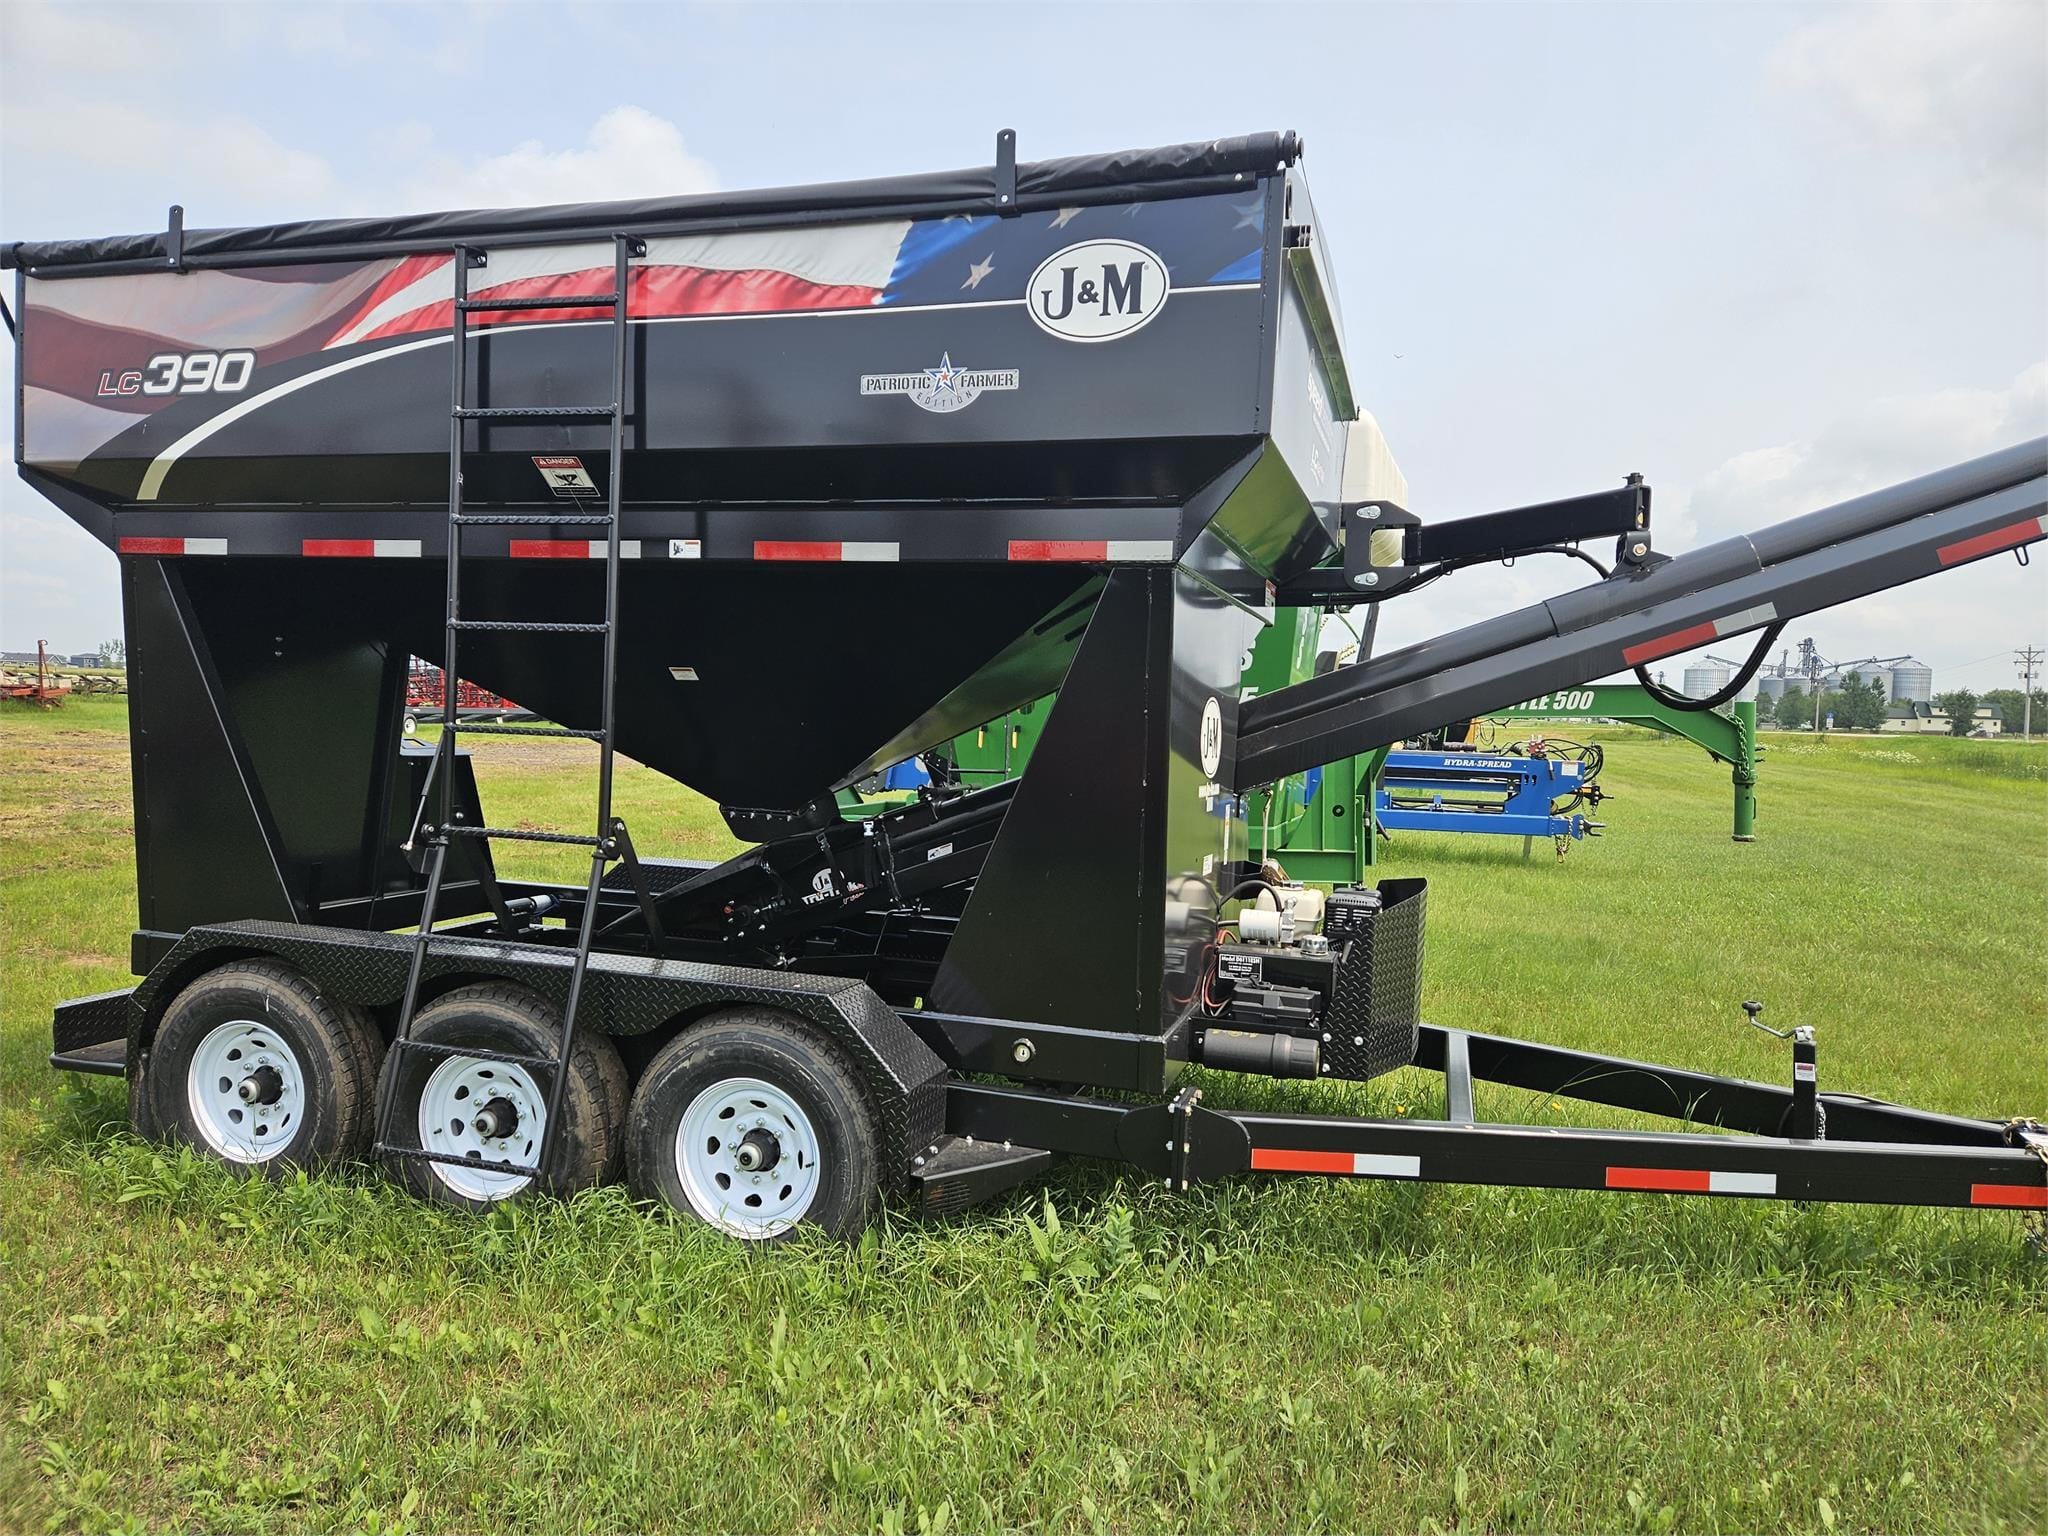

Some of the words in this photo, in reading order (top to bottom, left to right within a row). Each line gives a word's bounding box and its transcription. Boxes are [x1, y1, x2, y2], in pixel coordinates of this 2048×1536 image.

[98, 352, 255, 396] LC390
[866, 375, 931, 391] PATRIOTIC
[960, 373, 1014, 388] FARMER
[916, 389, 973, 407] EDITION
[1552, 690, 1595, 710] 500
[1443, 758, 1512, 769] HYDRA-SPREAD
